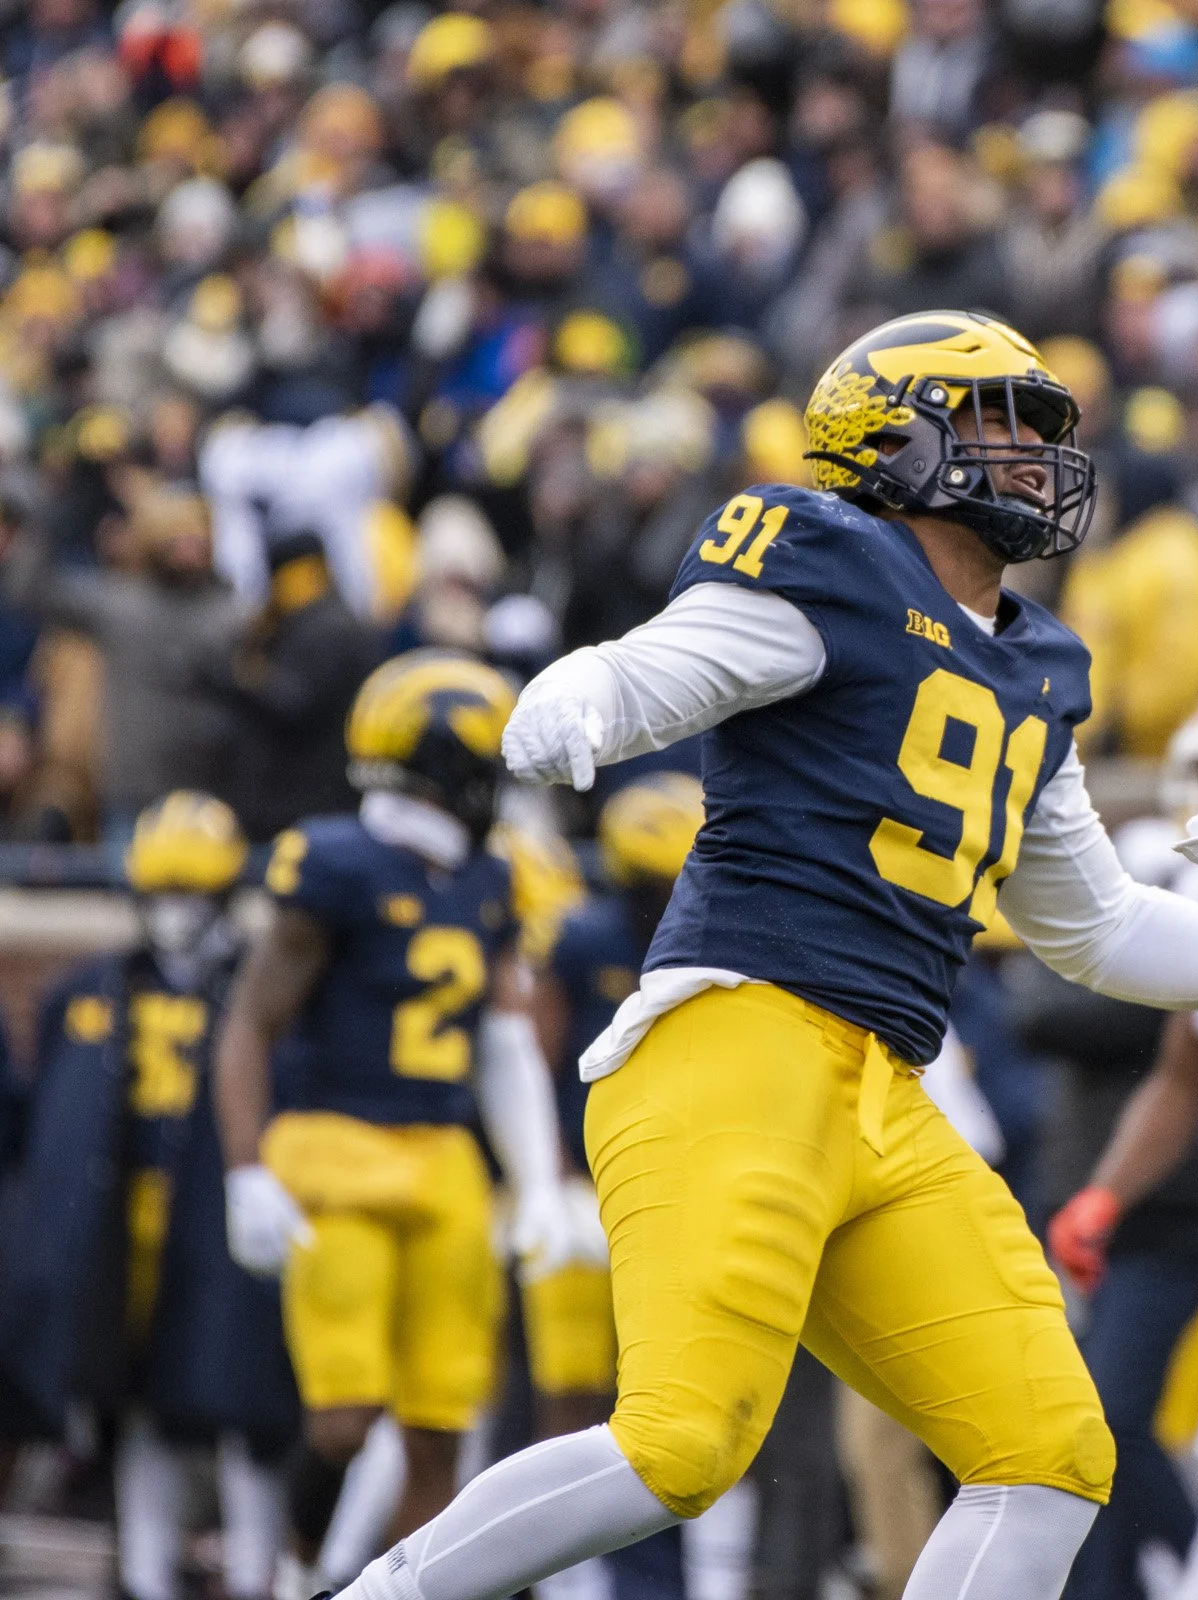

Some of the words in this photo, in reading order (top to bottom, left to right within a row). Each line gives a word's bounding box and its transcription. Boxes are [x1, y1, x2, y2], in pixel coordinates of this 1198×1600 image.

[699, 494, 790, 579] 91
[868, 668, 1048, 924] 91
[389, 926, 486, 1083] 2
